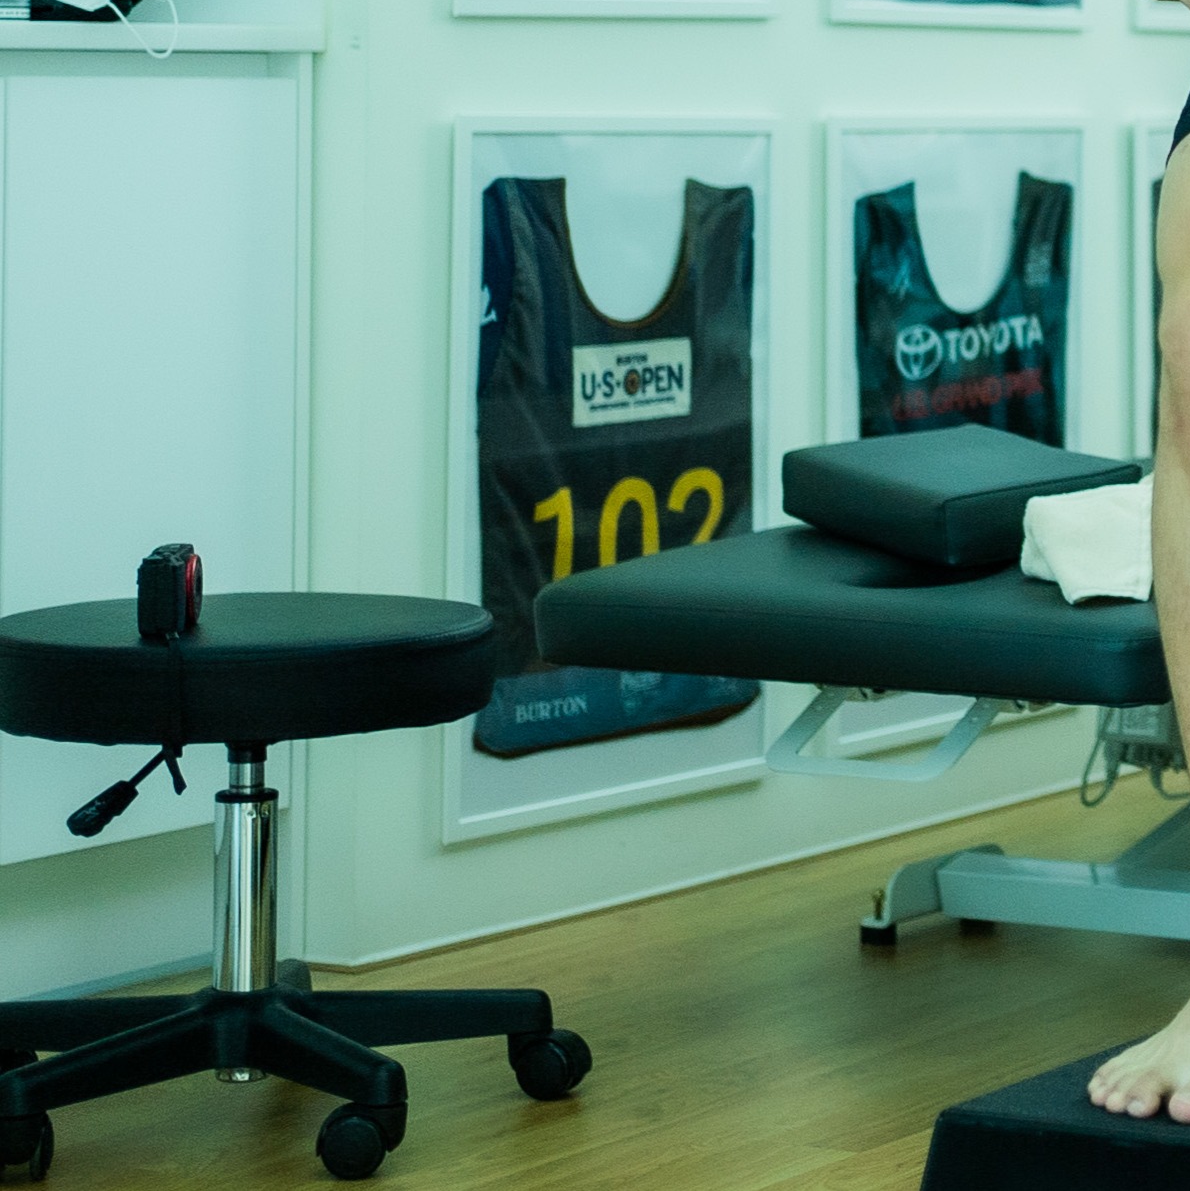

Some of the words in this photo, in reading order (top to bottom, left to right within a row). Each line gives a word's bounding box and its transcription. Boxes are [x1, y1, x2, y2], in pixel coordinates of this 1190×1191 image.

[944, 313, 1044, 363] TOYOTA
[534, 467, 724, 583] 102
[515, 694, 589, 724] BURTON
